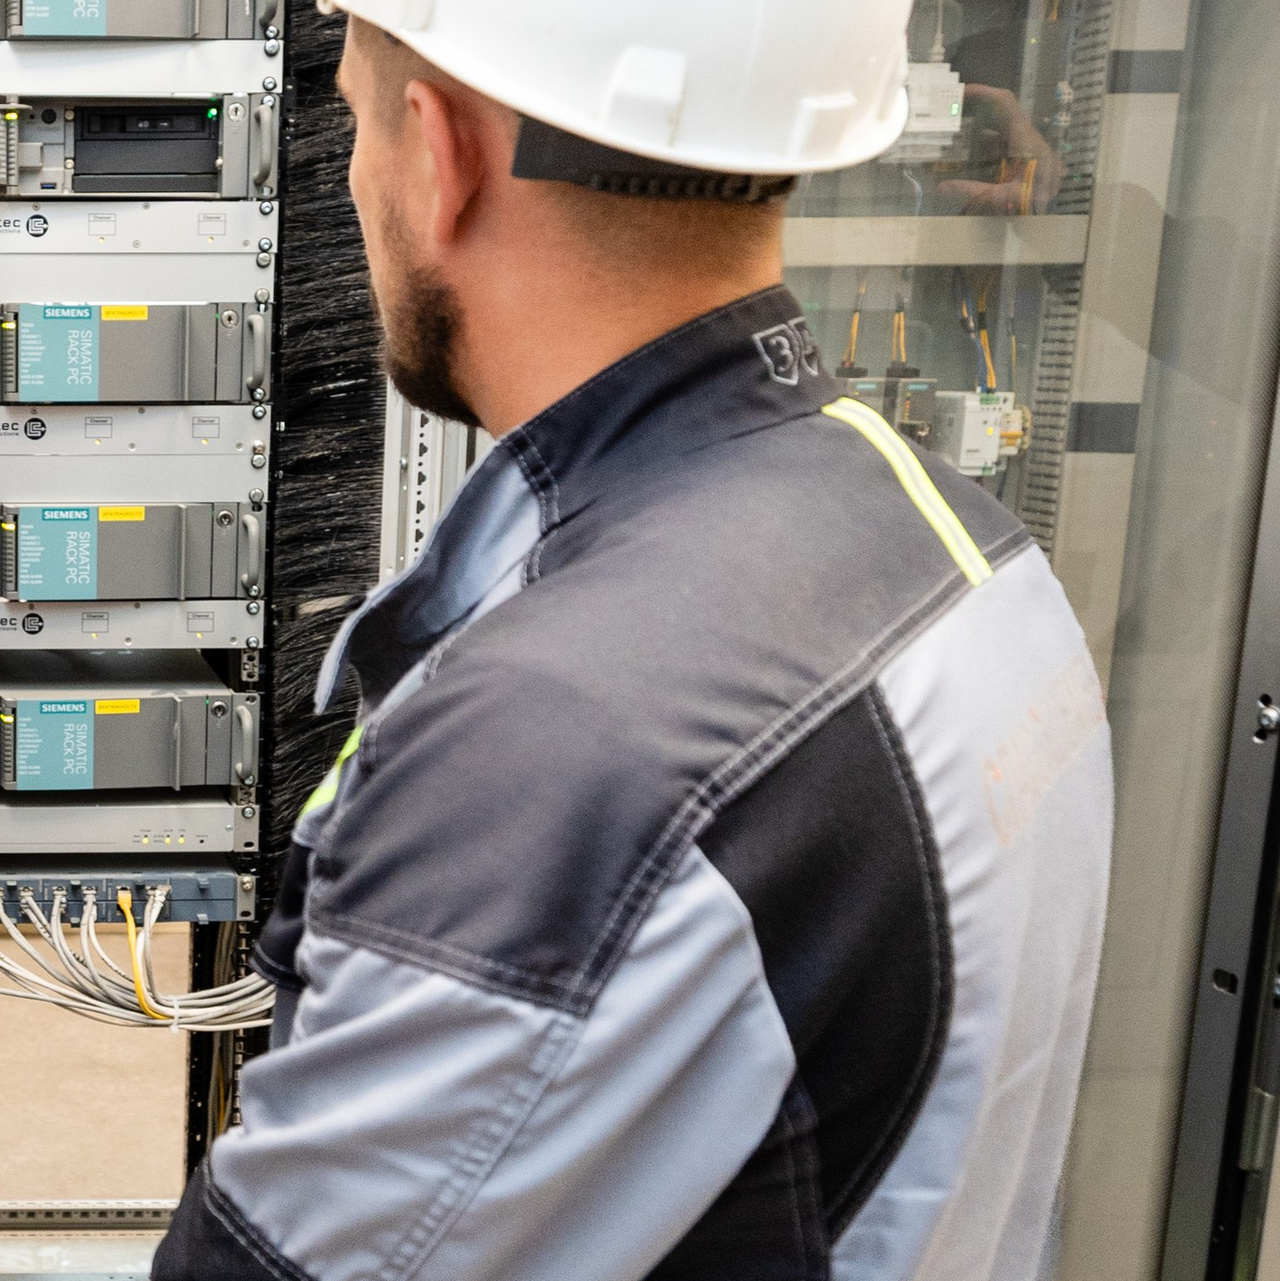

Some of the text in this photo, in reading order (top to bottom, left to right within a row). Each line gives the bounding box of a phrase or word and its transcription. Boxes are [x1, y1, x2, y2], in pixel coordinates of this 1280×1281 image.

[73, 0, 86, 18] PC
[45, 307, 90, 317] SIEMENS
[67, 329, 80, 385] RACK PC
[80, 330, 93, 385] SIMATIC
[43, 510, 89, 519] SIEMENS
[65, 530, 78, 584] RACK PC
[78, 531, 91, 584] SIMATIC
[41, 703, 86, 713] SIEMENS
[63, 723, 75, 775] RACK PC
[75, 723, 88, 775] SIMATIC
